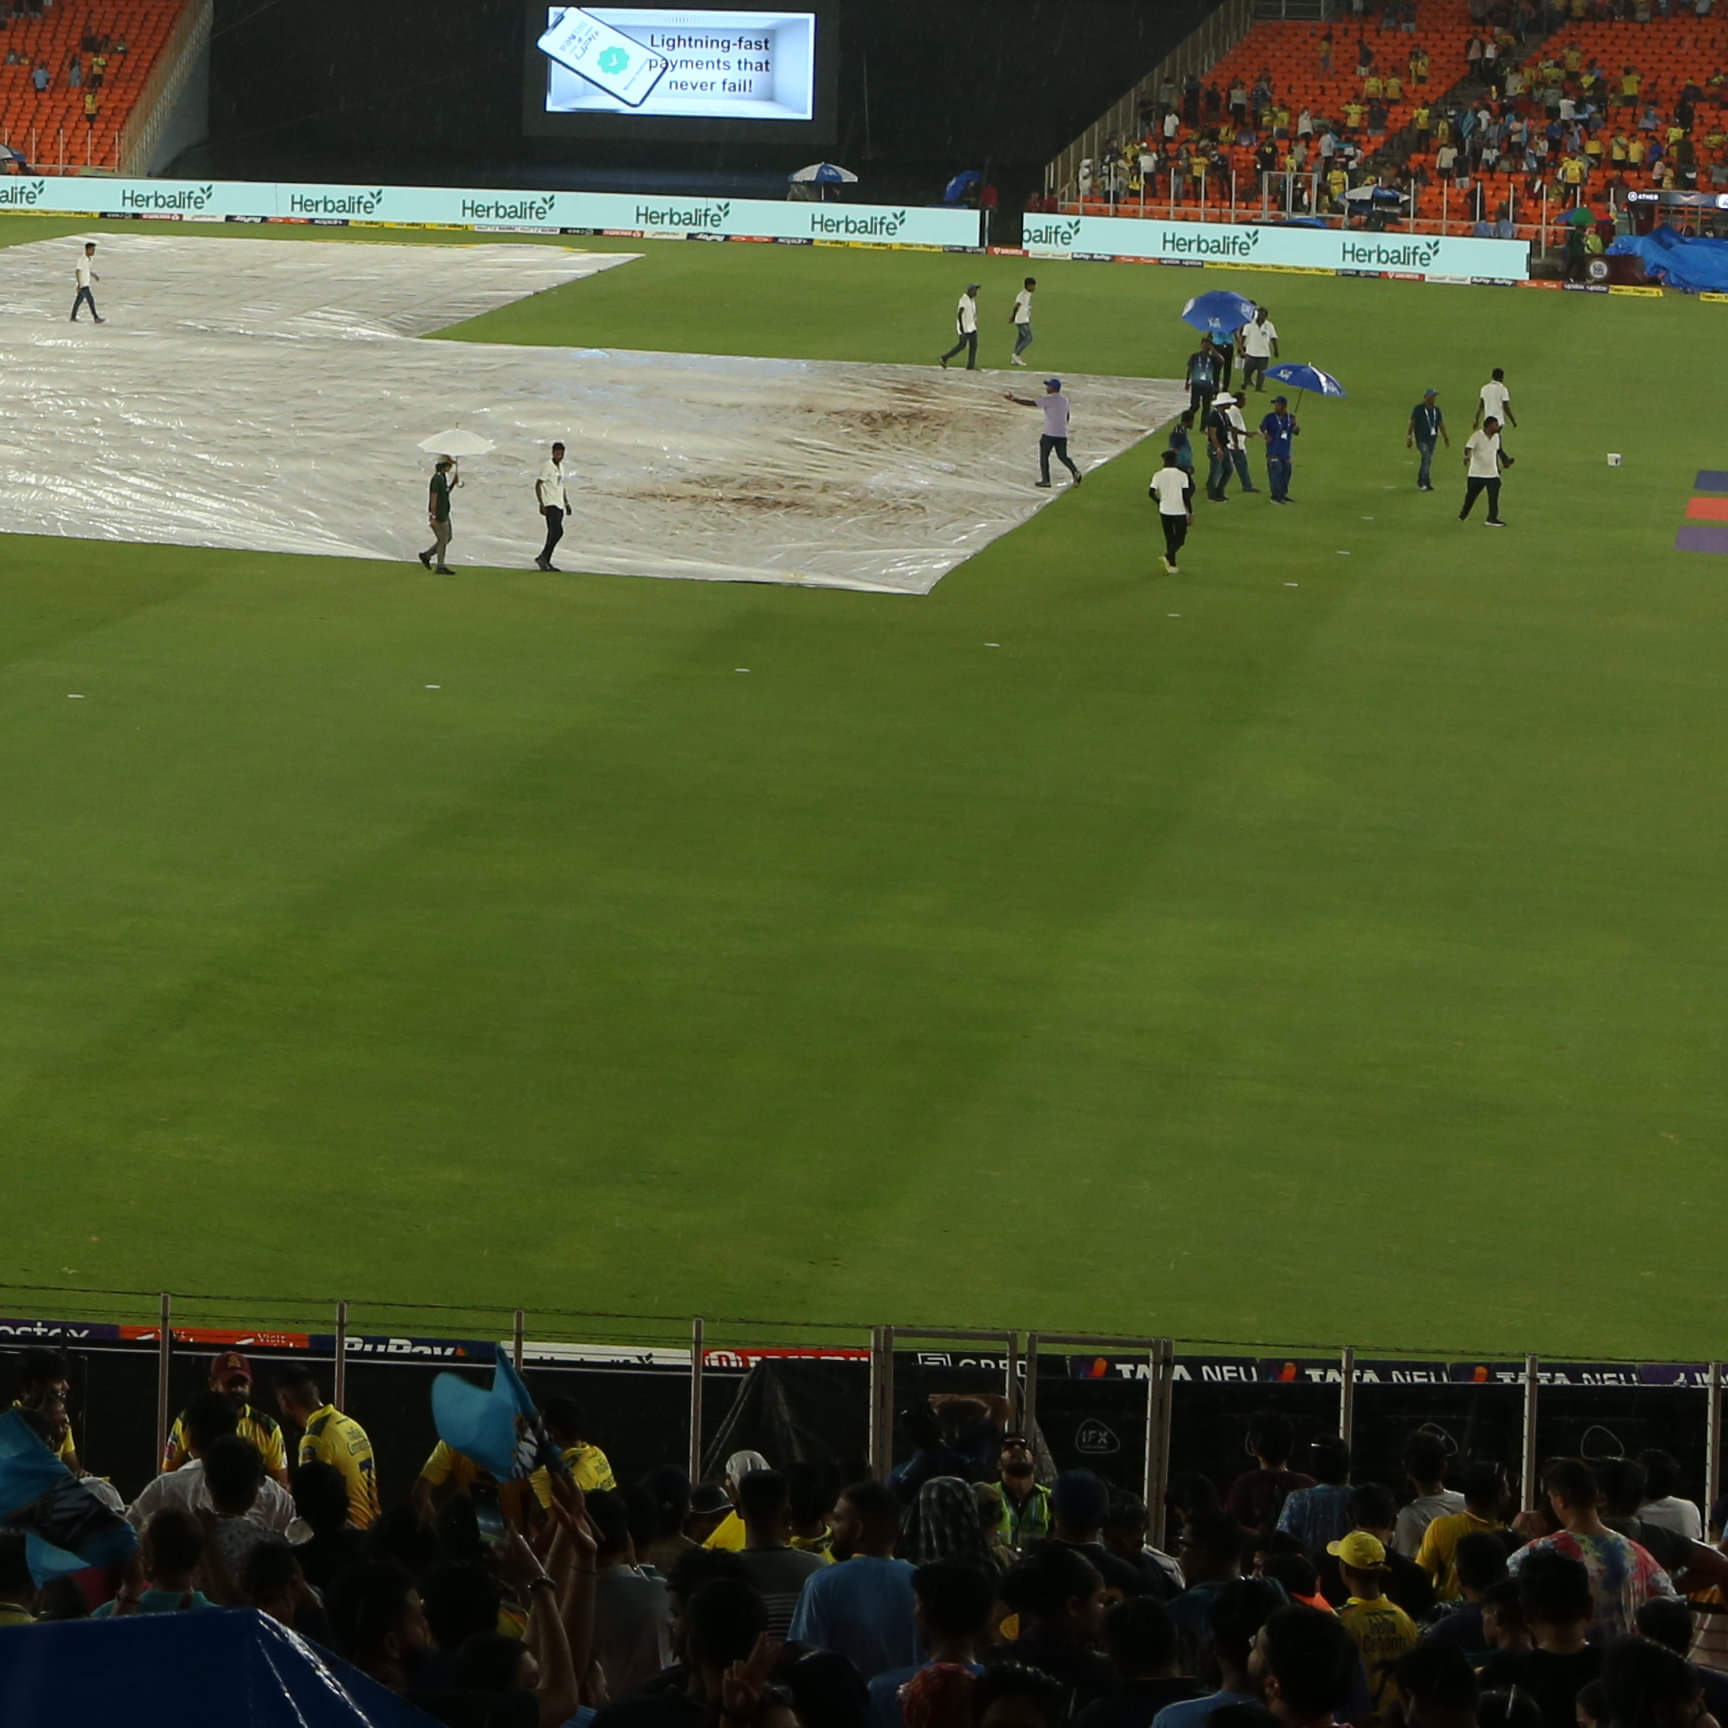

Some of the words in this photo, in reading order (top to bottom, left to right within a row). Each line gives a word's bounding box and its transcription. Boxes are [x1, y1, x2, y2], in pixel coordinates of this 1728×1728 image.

[649, 34, 770, 52] Lightning-fast
[648, 57, 731, 73] payments
[737, 58, 770, 73] that
[668, 80, 716, 92] never
[721, 78, 753, 93] fail!
[122, 187, 210, 210] Herbalife
[291, 191, 380, 215] Herbalife
[462, 197, 550, 220] Herbalife
[636, 204, 725, 228] Herbalife
[811, 212, 900, 236] Herbalife
[1162, 231, 1253, 257] Herbalife
[1342, 242, 1435, 267] Herbalife
[1114, 1362, 1193, 1382] TAA
[1200, 1363, 1258, 1383] NEU
[1081, 1429, 1111, 1447] IFX
